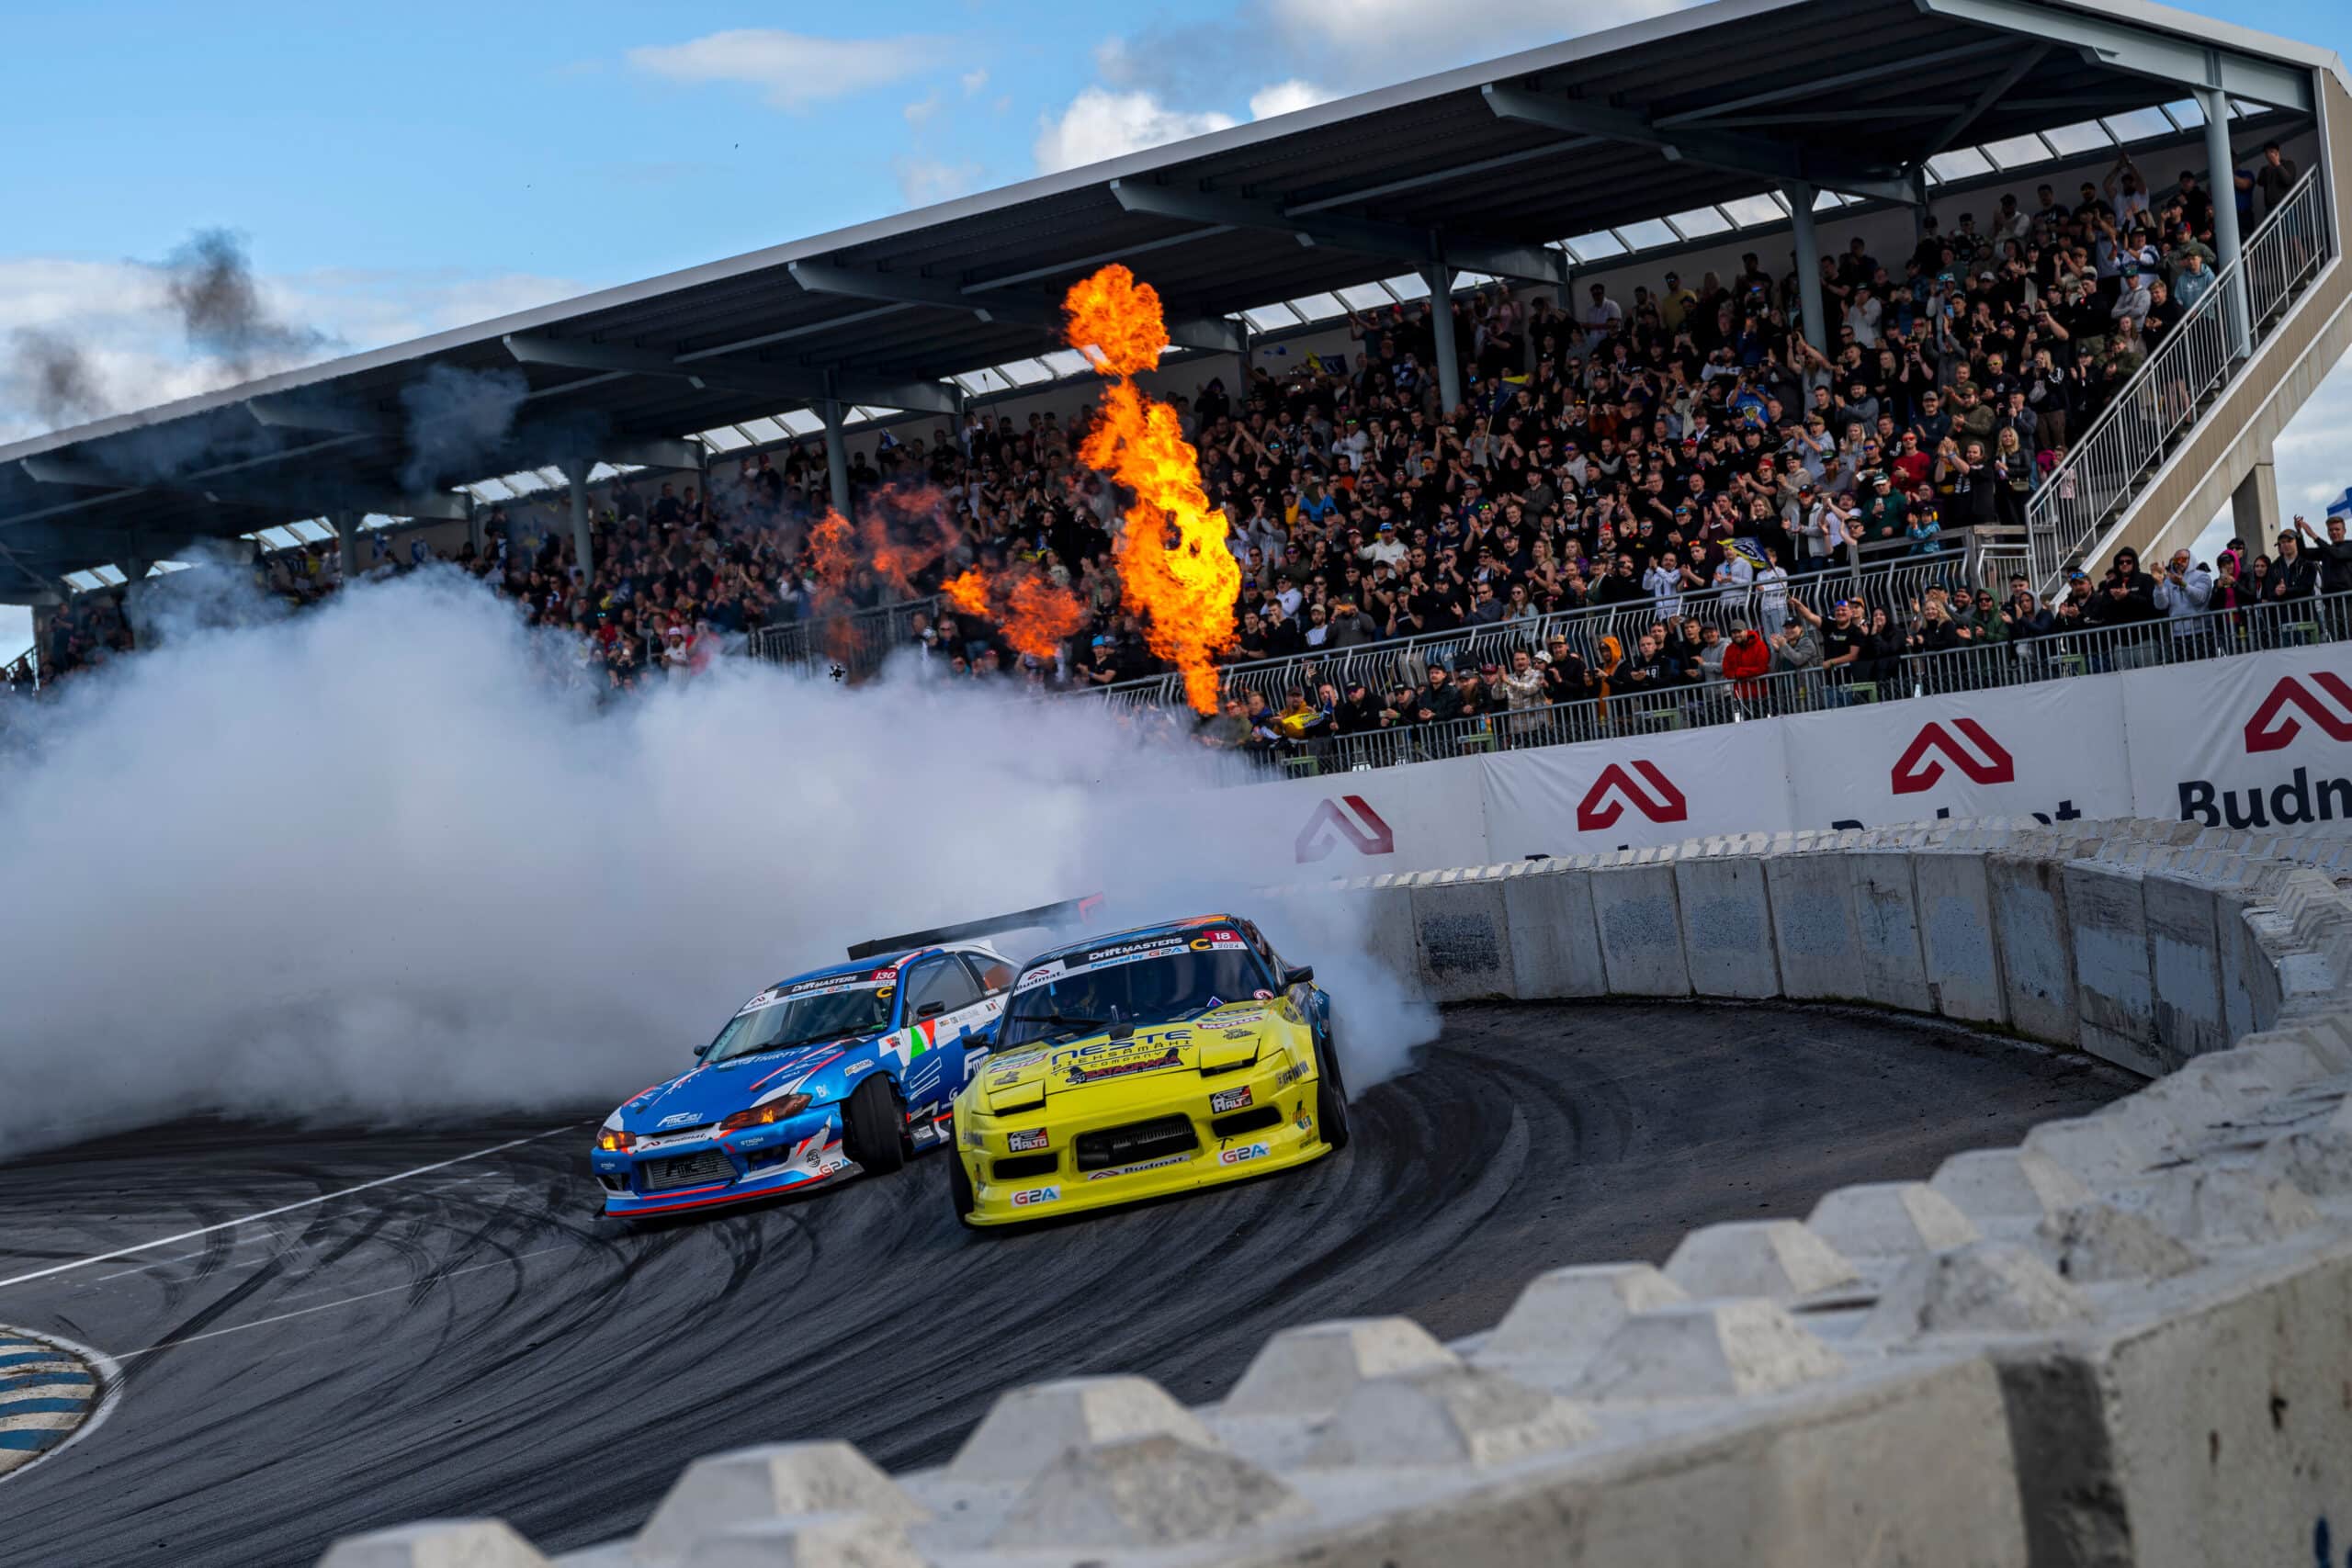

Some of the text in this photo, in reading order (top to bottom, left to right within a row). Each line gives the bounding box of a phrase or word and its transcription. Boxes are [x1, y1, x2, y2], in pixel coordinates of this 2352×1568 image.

[1189, 938, 1212, 950] C
[1215, 932, 1231, 941] 18
[1091, 954, 1130, 969] Powered
[1148, 947, 1183, 957] G2A
[876, 972, 897, 980] 130
[876, 986, 894, 999] C
[1222, 1145, 1266, 1164] G2A
[820, 1158, 853, 1176] G2A
[1014, 1188, 1057, 1205] G2A
